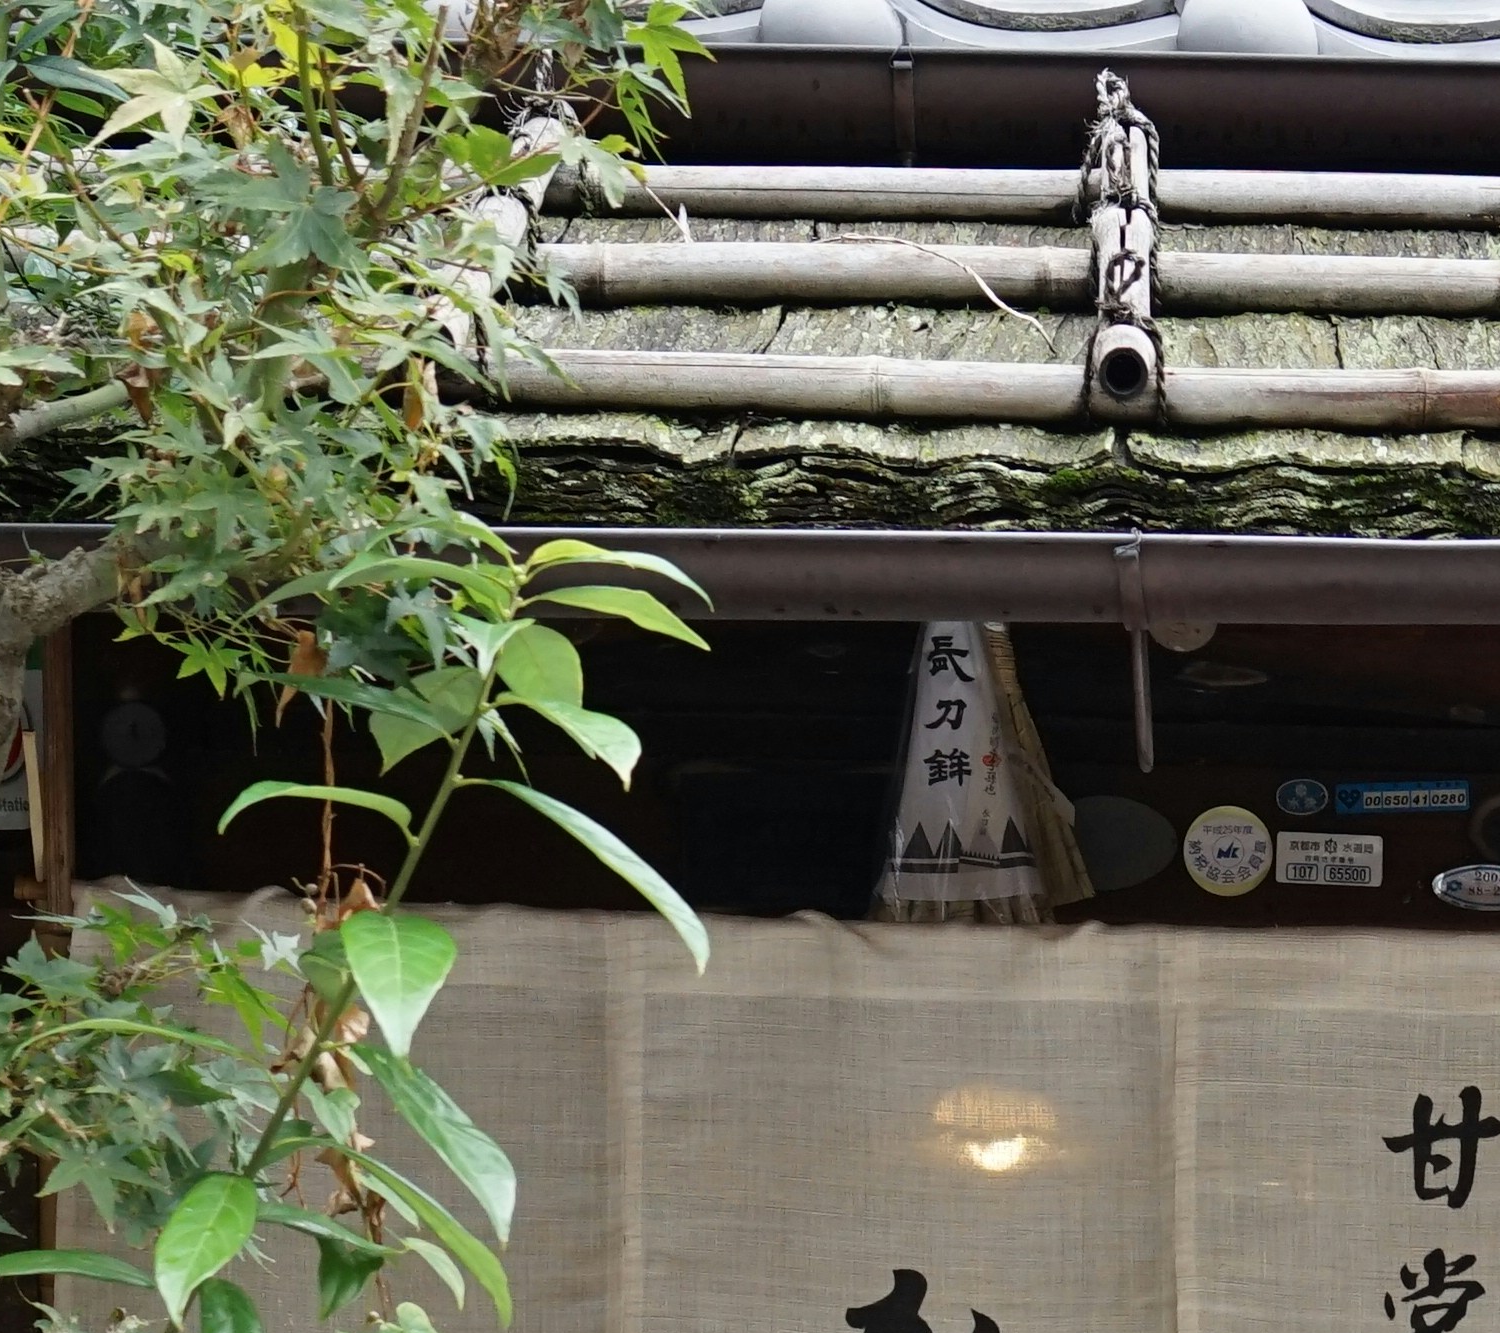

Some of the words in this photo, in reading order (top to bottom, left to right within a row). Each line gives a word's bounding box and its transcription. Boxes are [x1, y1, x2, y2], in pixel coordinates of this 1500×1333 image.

[923, 636, 975, 787] 長刀鉾
[1289, 840, 1321, 852] 京都市
[1292, 866, 1313, 880] 107
[1329, 867, 1366, 881] 65500
